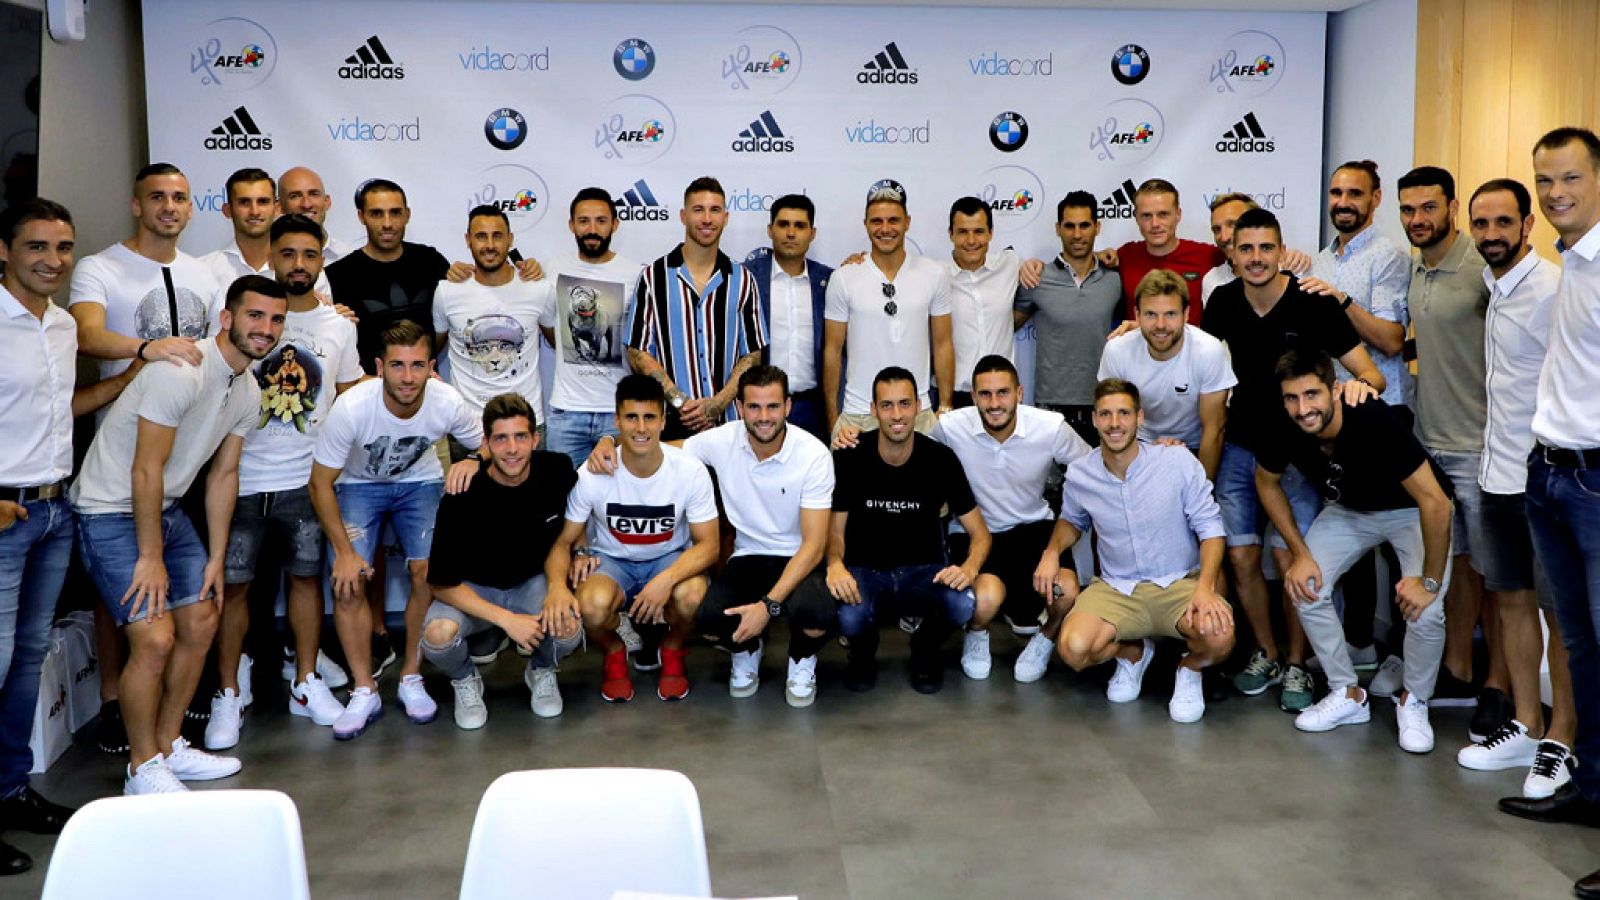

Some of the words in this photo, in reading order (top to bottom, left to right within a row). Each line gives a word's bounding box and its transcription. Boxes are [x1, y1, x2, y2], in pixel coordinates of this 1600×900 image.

[214, 55, 243, 68] AFE
[459, 46, 549, 71] vidacord
[968, 52, 1052, 76] vidacord
[338, 64, 404, 79] adidas
[743, 61, 770, 73] AFE
[1229, 65, 1255, 76] AFE
[857, 68, 918, 84] adidas
[328, 116, 420, 141] vidacord
[616, 130, 643, 142] AFE
[845, 120, 930, 143] vidacord
[204, 134, 272, 150] adidas
[732, 137, 794, 152] adidas
[1110, 132, 1135, 144] AFE
[1215, 138, 1275, 152] adidas
[616, 205, 669, 221] didas
[1097, 205, 1137, 219] adid
[866, 500, 920, 509] GIVENCHY
